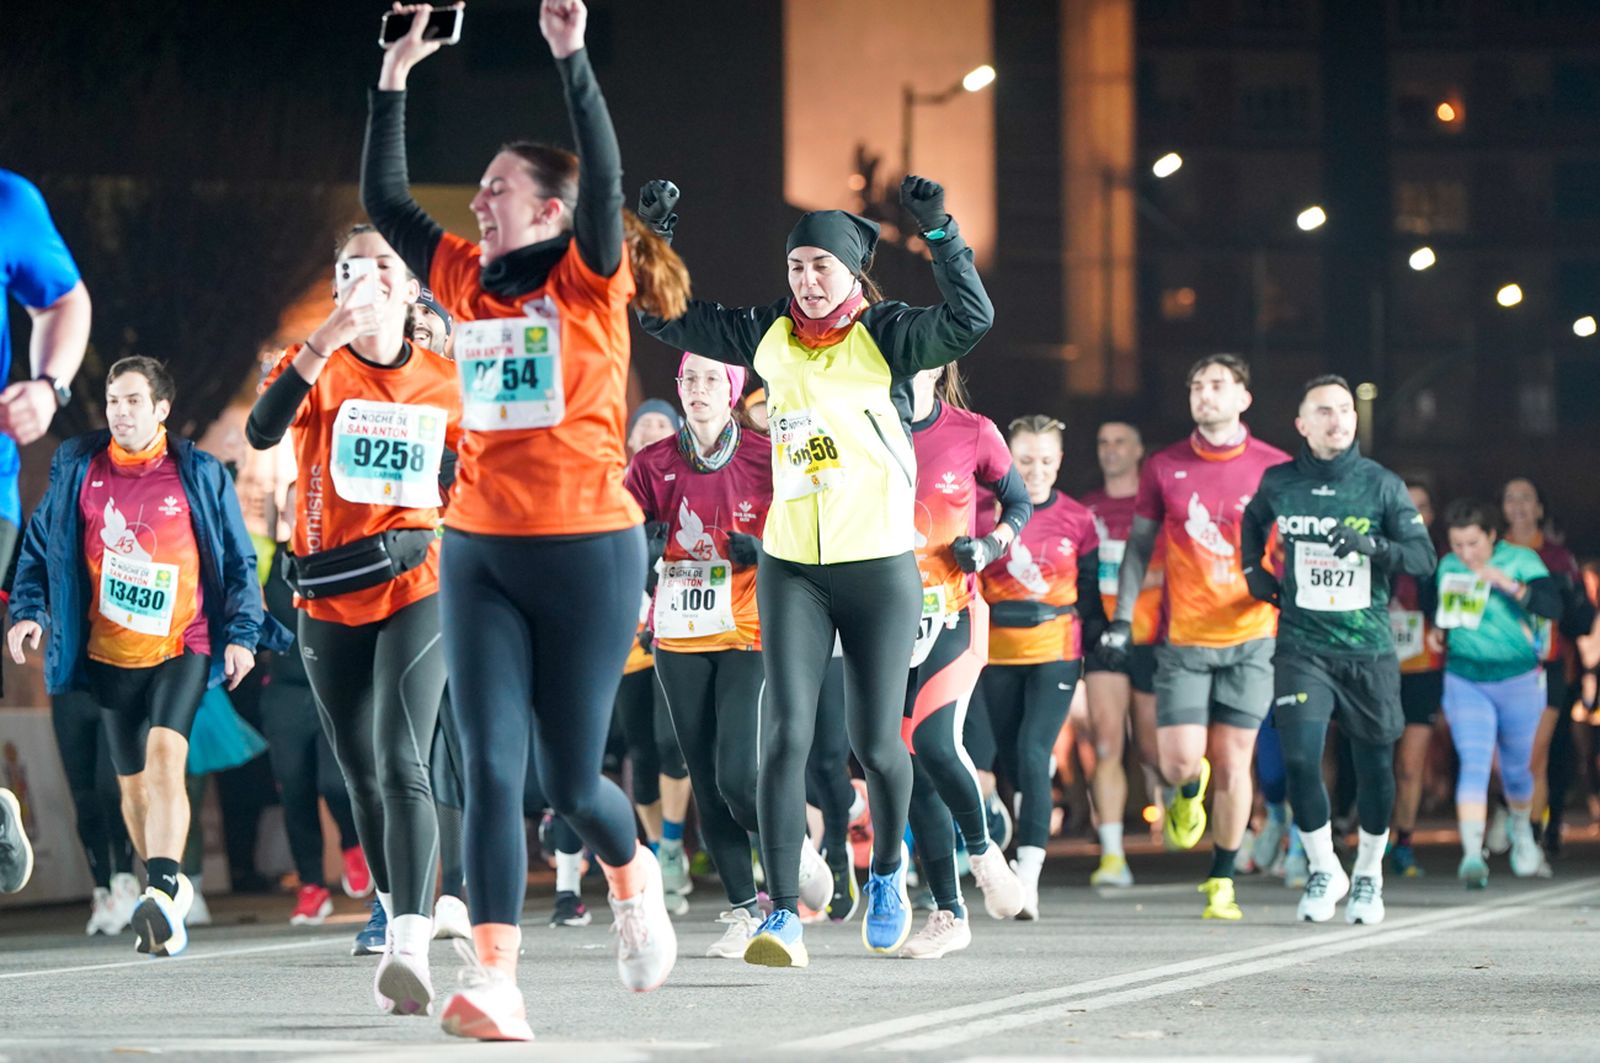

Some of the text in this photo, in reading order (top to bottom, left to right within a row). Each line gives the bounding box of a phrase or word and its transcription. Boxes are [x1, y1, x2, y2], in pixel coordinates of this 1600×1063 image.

[361, 413, 409, 427] NOCHE DE
[346, 422, 370, 436] SAN
[353, 437, 426, 472] 9258
[114, 536, 135, 553] 43
[693, 539, 713, 560] 43
[118, 564, 139, 575] NOCHE
[693, 569, 703, 578] DE
[1311, 568, 1355, 587] 5827
[108, 578, 166, 611] 13430
